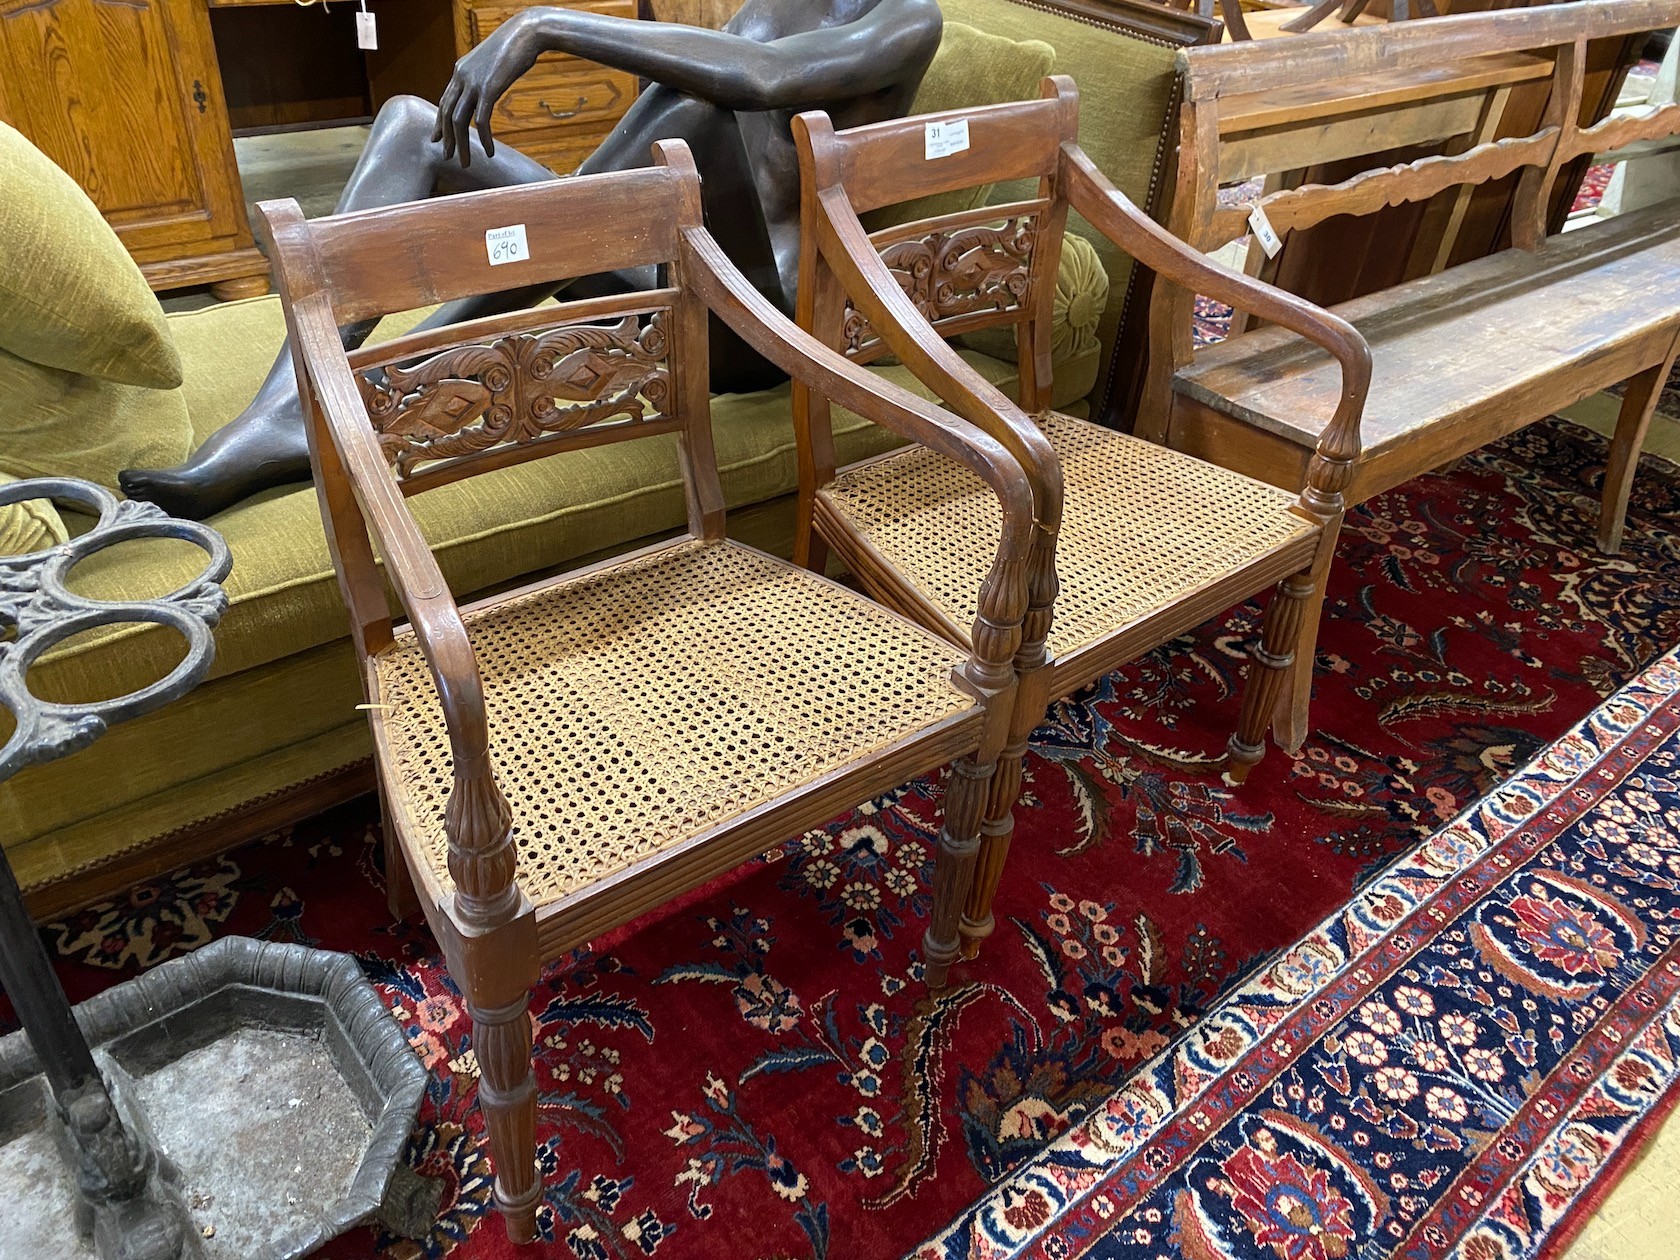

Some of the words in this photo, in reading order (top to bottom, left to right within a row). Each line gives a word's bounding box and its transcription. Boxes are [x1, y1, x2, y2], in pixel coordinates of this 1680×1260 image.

[931, 127, 940, 138] 31
[1263, 231, 1272, 242] 30
[493, 240, 517, 260] 690
